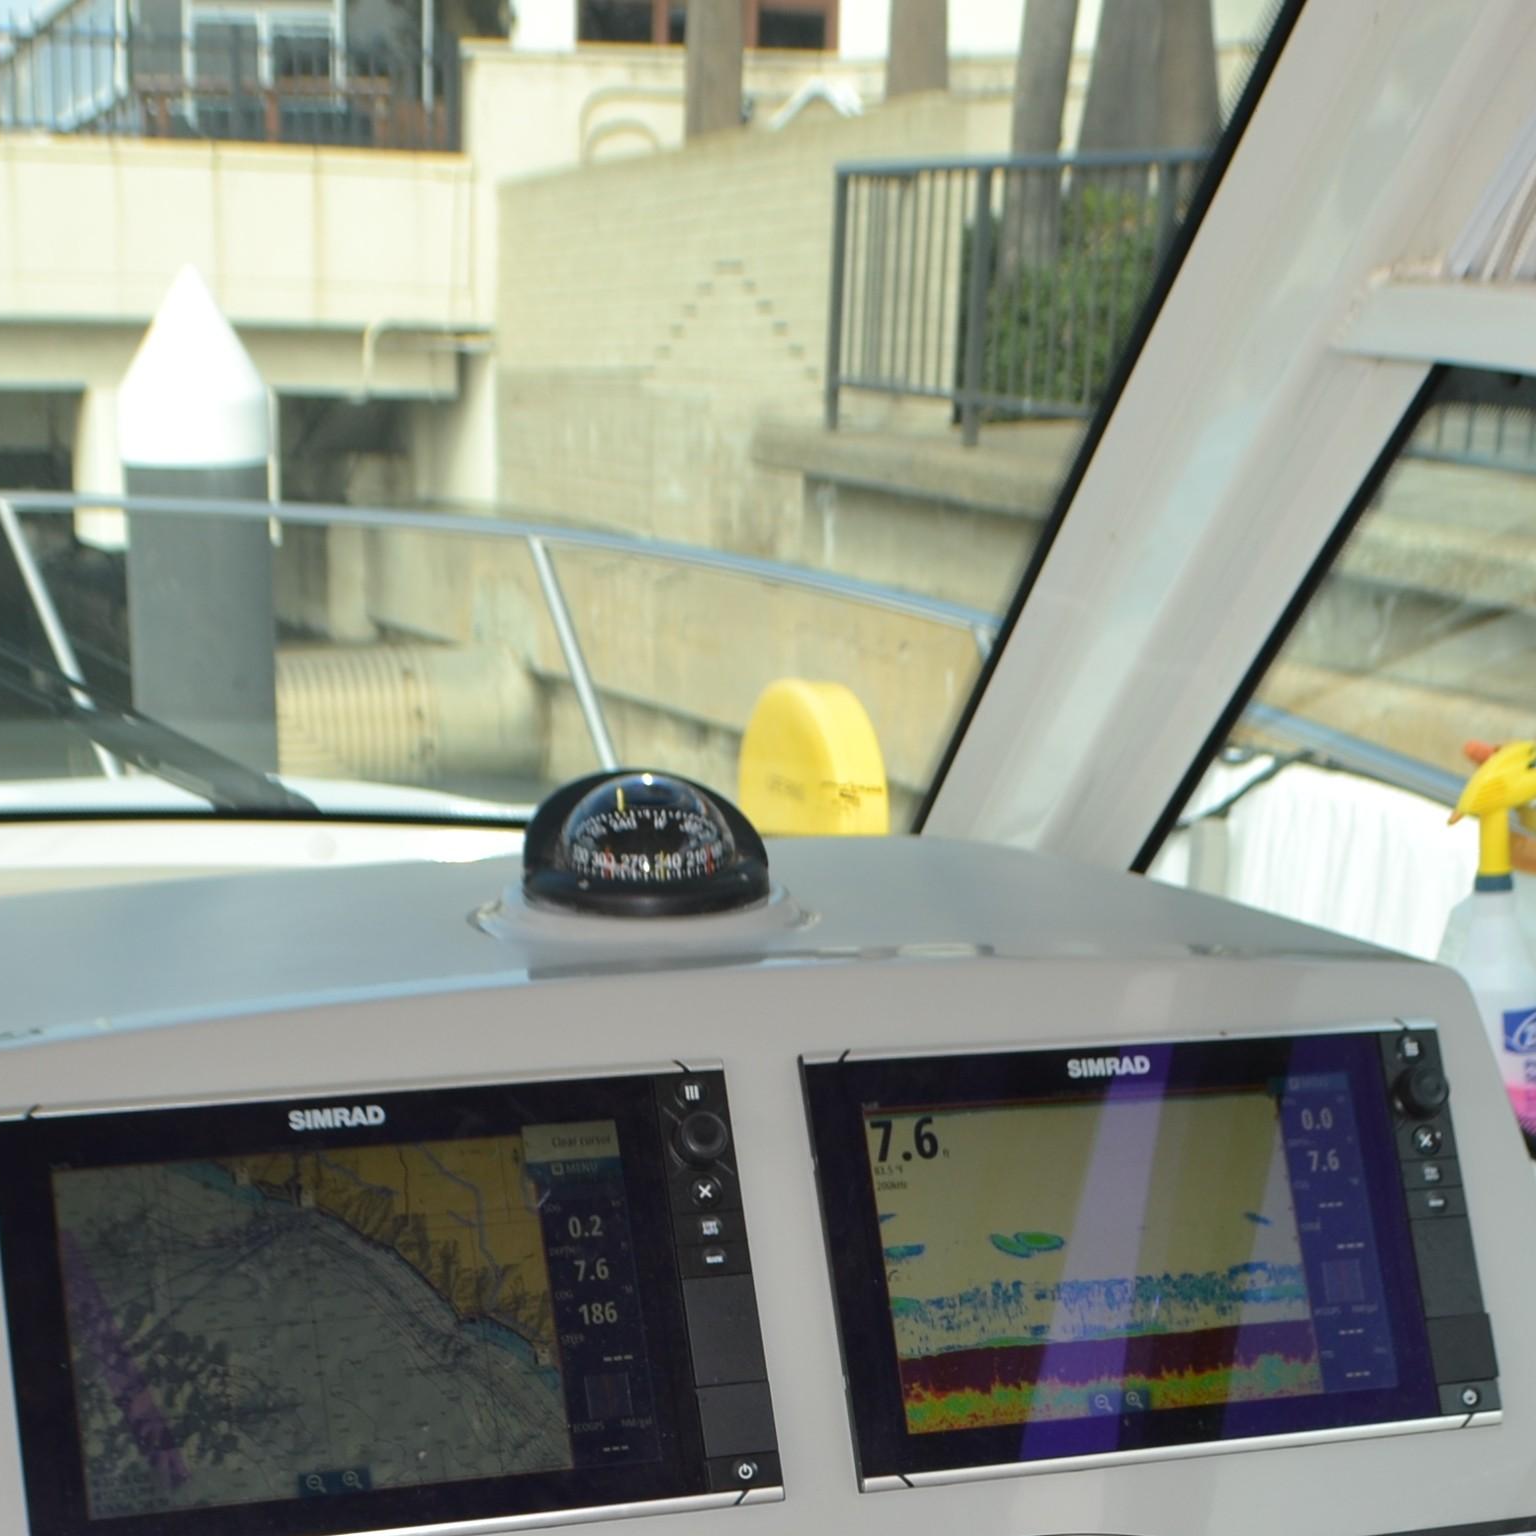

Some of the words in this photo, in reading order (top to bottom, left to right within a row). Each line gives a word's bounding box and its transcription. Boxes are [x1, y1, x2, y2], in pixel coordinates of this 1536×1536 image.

[620, 853, 648, 869] 270
[1067, 1055, 1151, 1078] SIMRAD
[289, 1105, 386, 1131] SIMRAD
[1302, 1107, 1333, 1130] 0.0
[869, 1115, 939, 1163] 7.6
[1307, 1148, 1340, 1172] 7.6
[568, 1214, 603, 1238] 0.2
[573, 1258, 609, 1282] 7.6
[578, 1302, 618, 1325] 186
